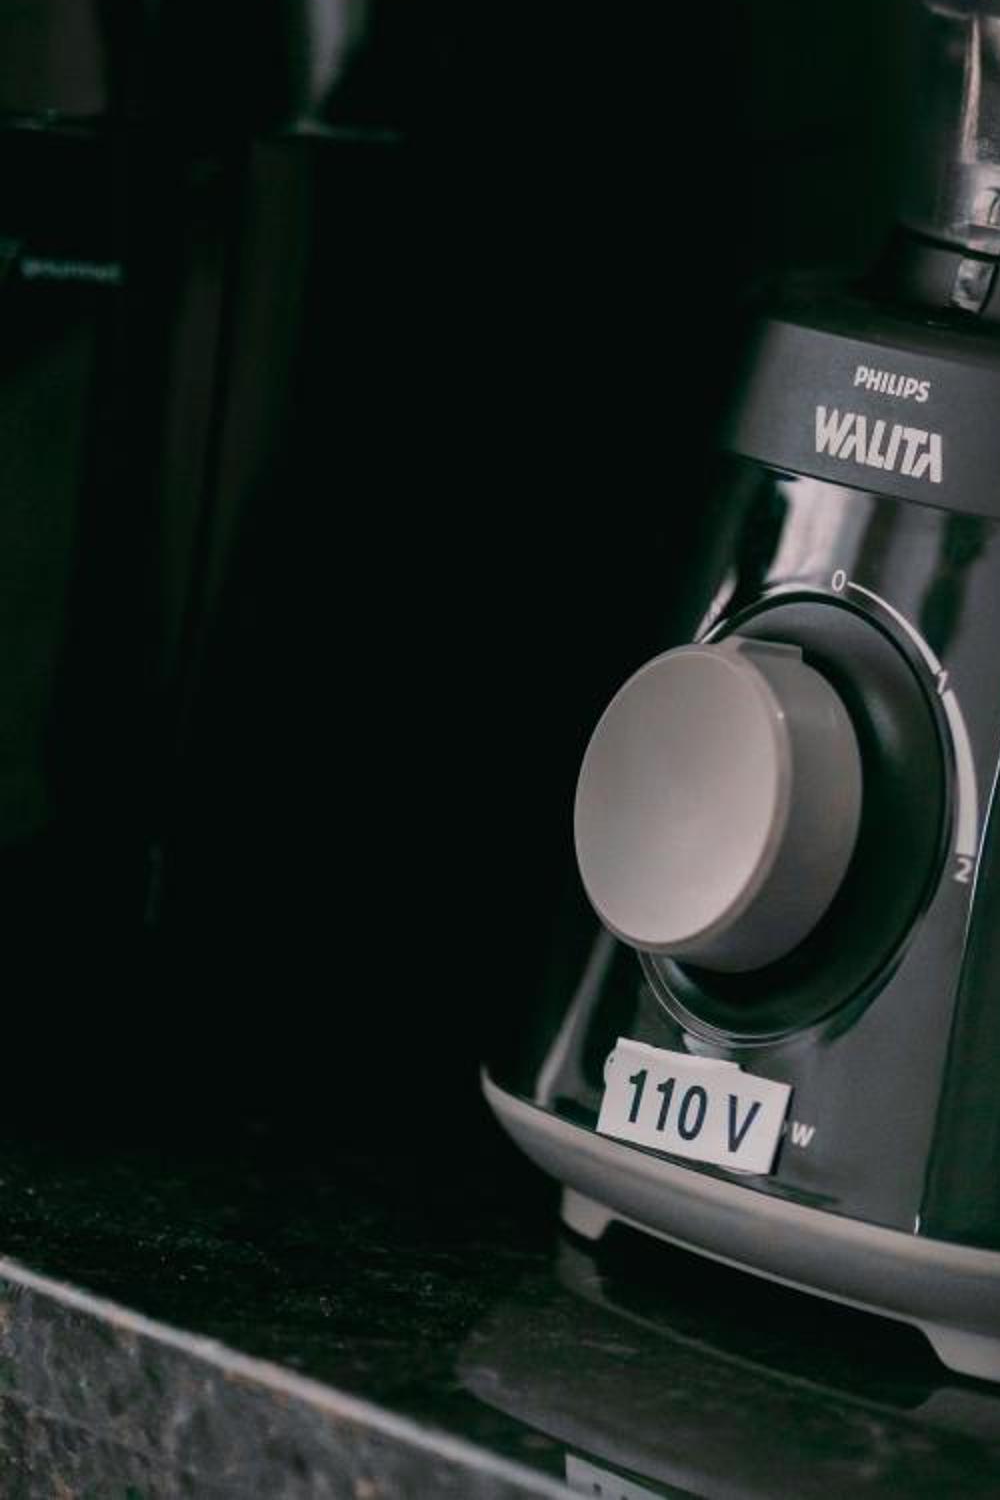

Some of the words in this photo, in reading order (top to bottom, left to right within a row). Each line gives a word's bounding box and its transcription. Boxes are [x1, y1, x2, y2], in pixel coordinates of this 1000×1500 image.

[853, 365, 931, 402] PHILIPS
[815, 405, 943, 483] WALITA
[831, 569, 846, 592] 0
[953, 856, 972, 883] 2
[628, 1068, 708, 1141] 110
[728, 1093, 762, 1153] V
